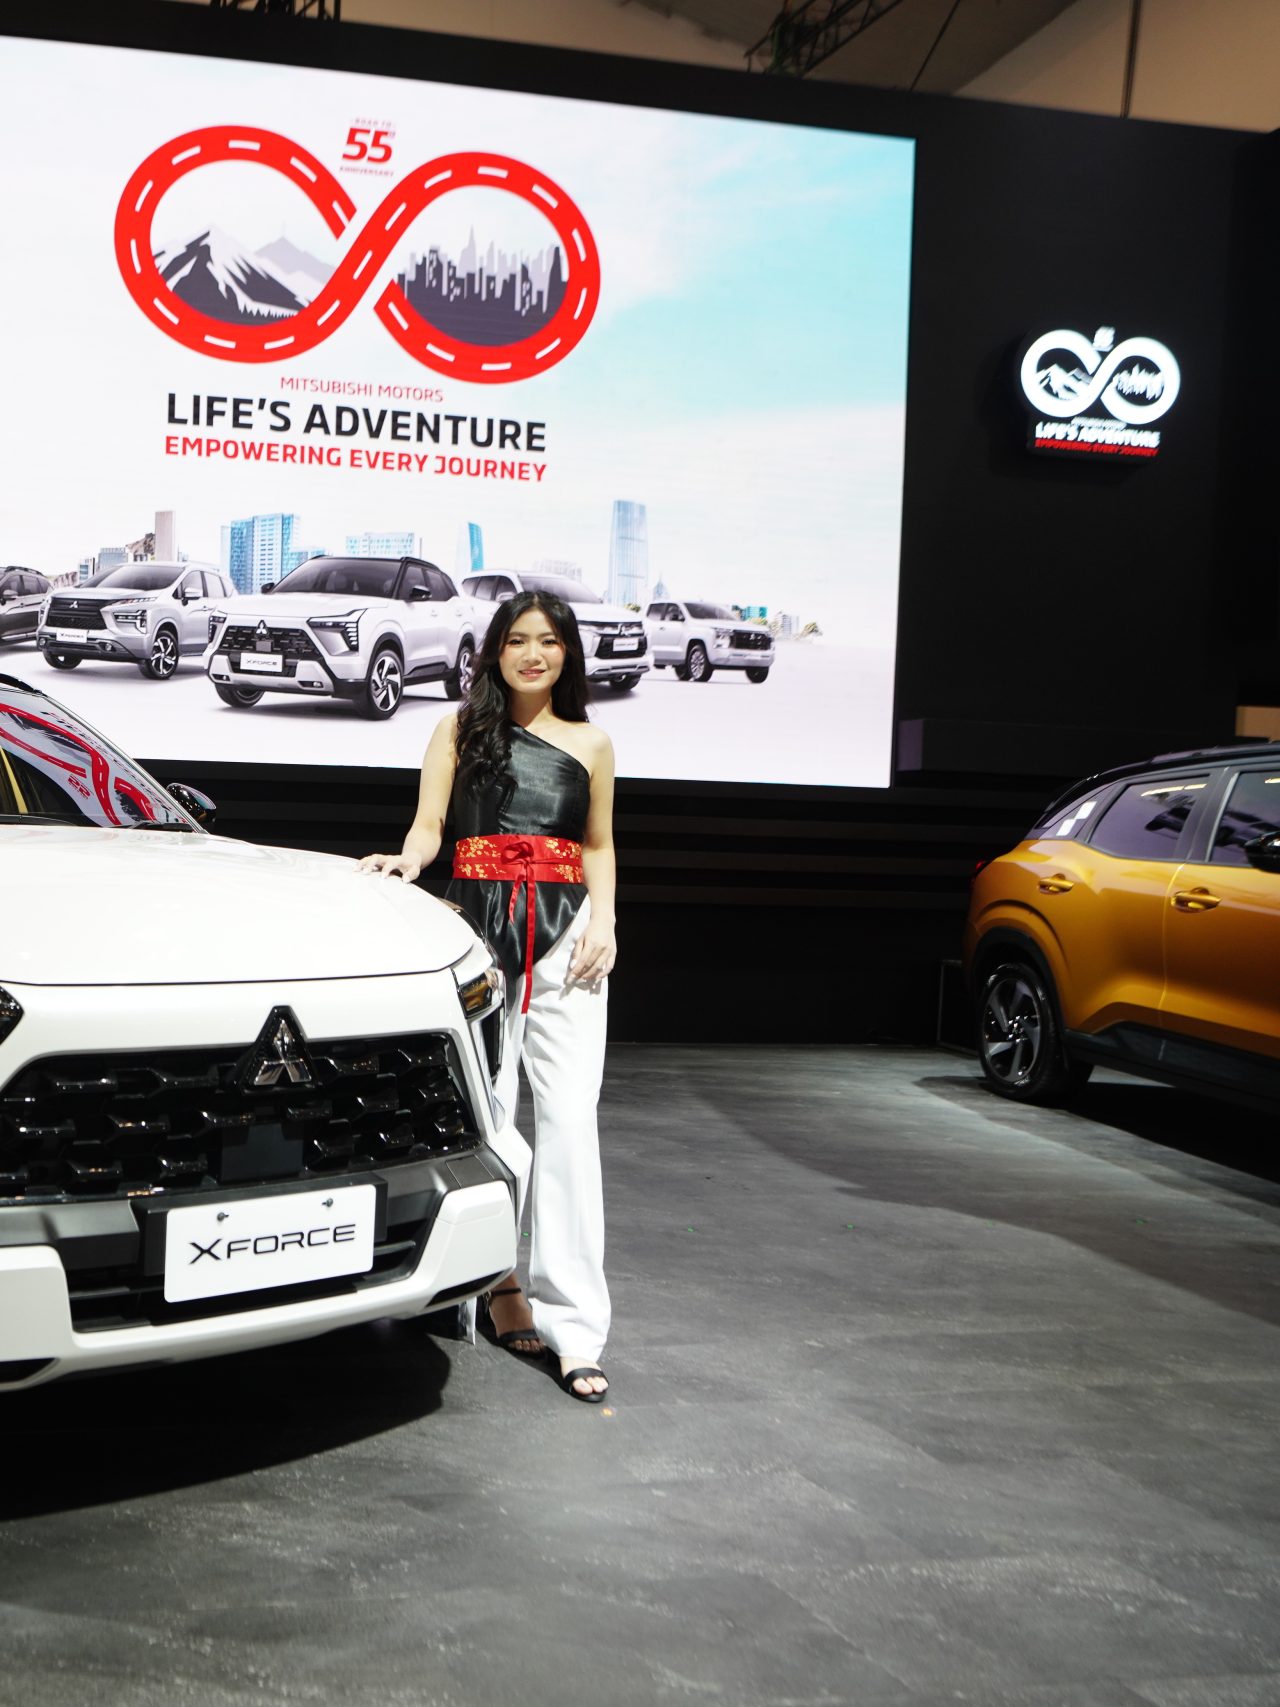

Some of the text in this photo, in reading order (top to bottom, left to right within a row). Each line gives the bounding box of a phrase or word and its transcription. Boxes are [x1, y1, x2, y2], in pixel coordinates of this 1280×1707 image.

[280, 377, 444, 403] MITSUBISHI MOTORS
[167, 392, 547, 453] LIFE'S ADVENTURE
[165, 435, 548, 482] EMPOWERING EVERY JOURNEY
[189, 1224, 356, 1264] XFORCE
